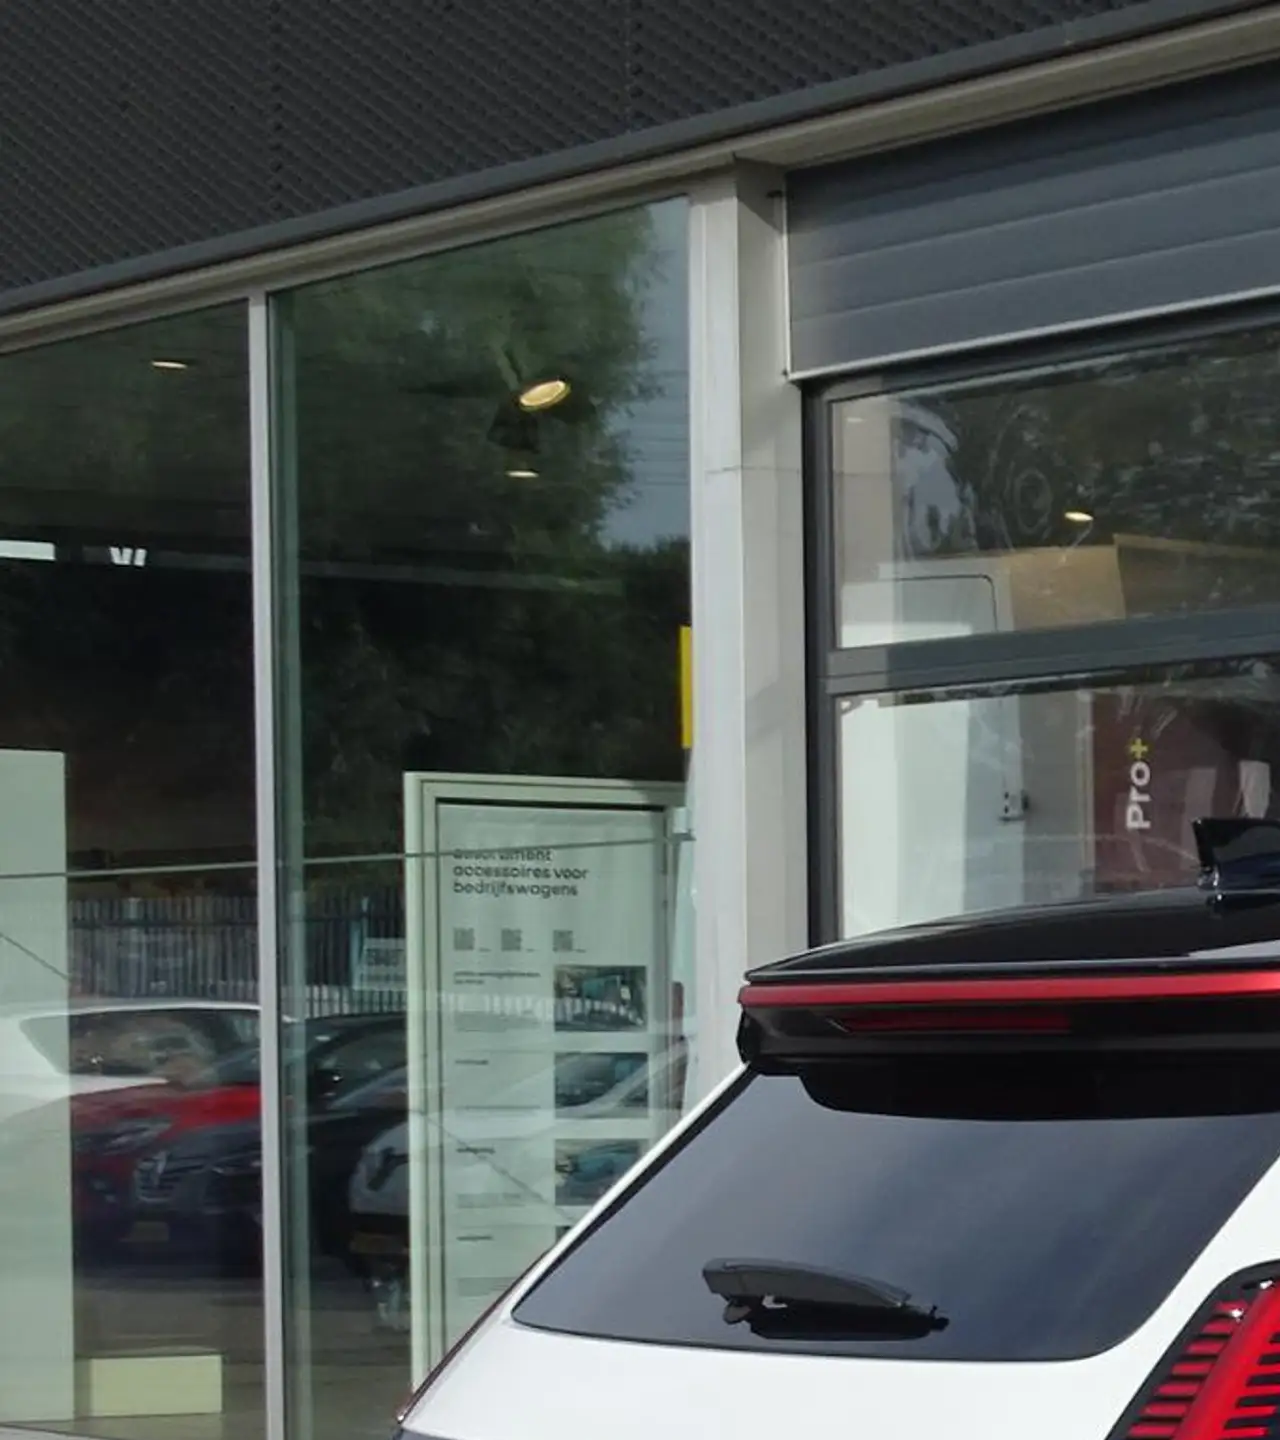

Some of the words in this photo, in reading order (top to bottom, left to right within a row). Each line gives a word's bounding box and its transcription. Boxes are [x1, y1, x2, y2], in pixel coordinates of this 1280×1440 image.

[1126, 737, 1151, 830] Pro+
[453, 863, 552, 878] accessoires
[554, 866, 589, 880] voor
[453, 879, 579, 899] bedrijfswagens
